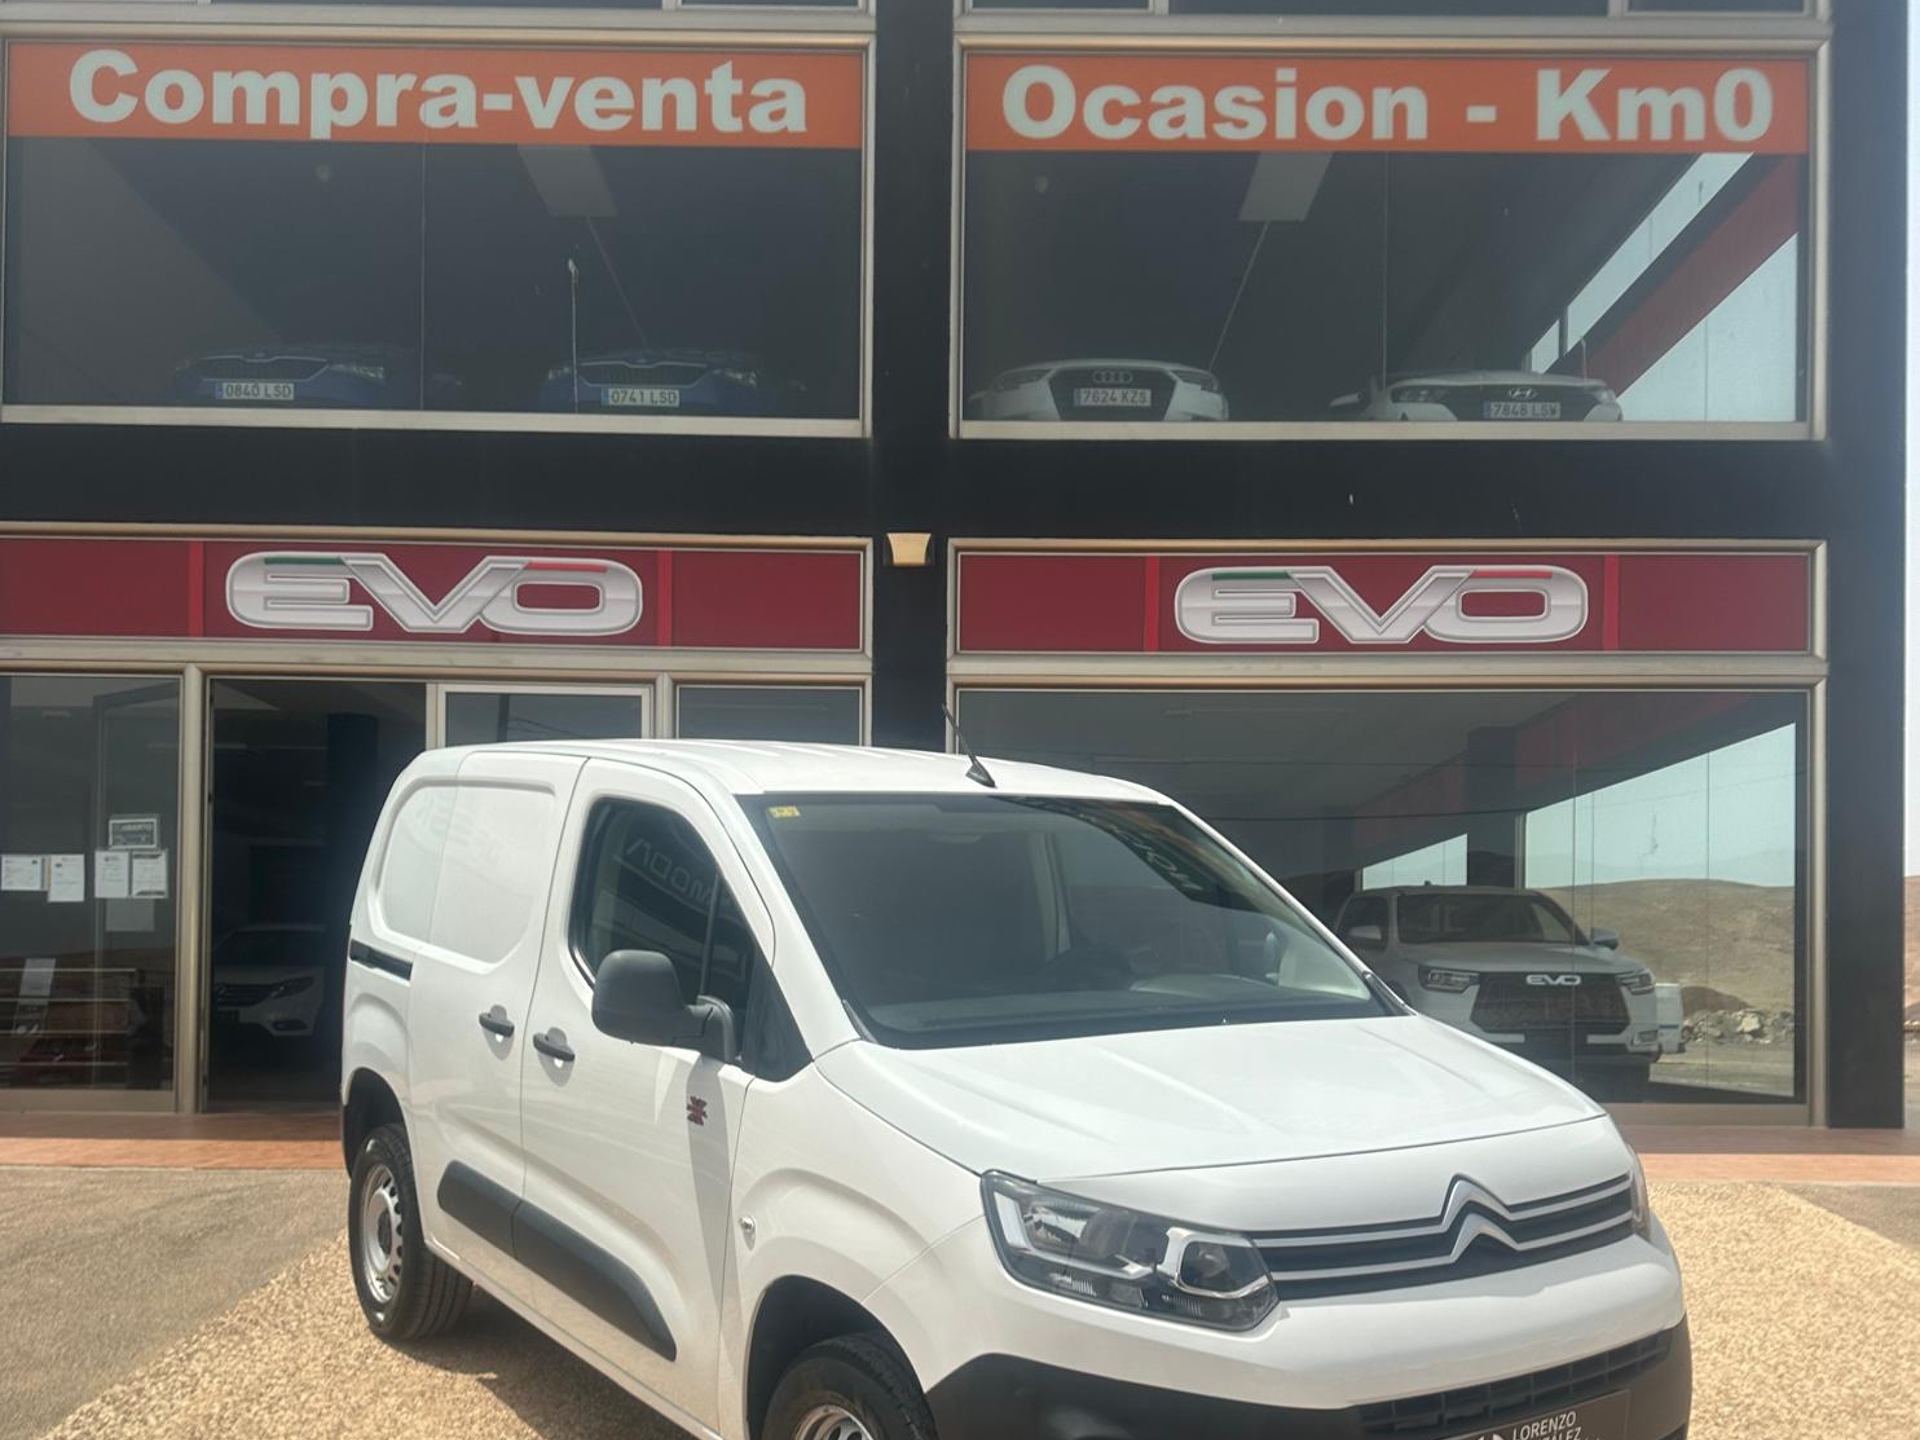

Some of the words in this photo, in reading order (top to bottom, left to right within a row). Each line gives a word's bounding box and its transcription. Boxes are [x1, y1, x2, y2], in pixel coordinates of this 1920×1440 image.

[68, 49, 807, 140] Compra-venta
[1003, 64, 1429, 142] Ocasion
[1466, 104, 1498, 123] -
[1536, 67, 1775, 143] Km0
[264, 385, 292, 399] LSD
[226, 551, 643, 636] EVO
[1175, 565, 1589, 644] EVO
[1526, 974, 1582, 986] EVO
[1512, 1410, 1577, 1440] LORENZO
